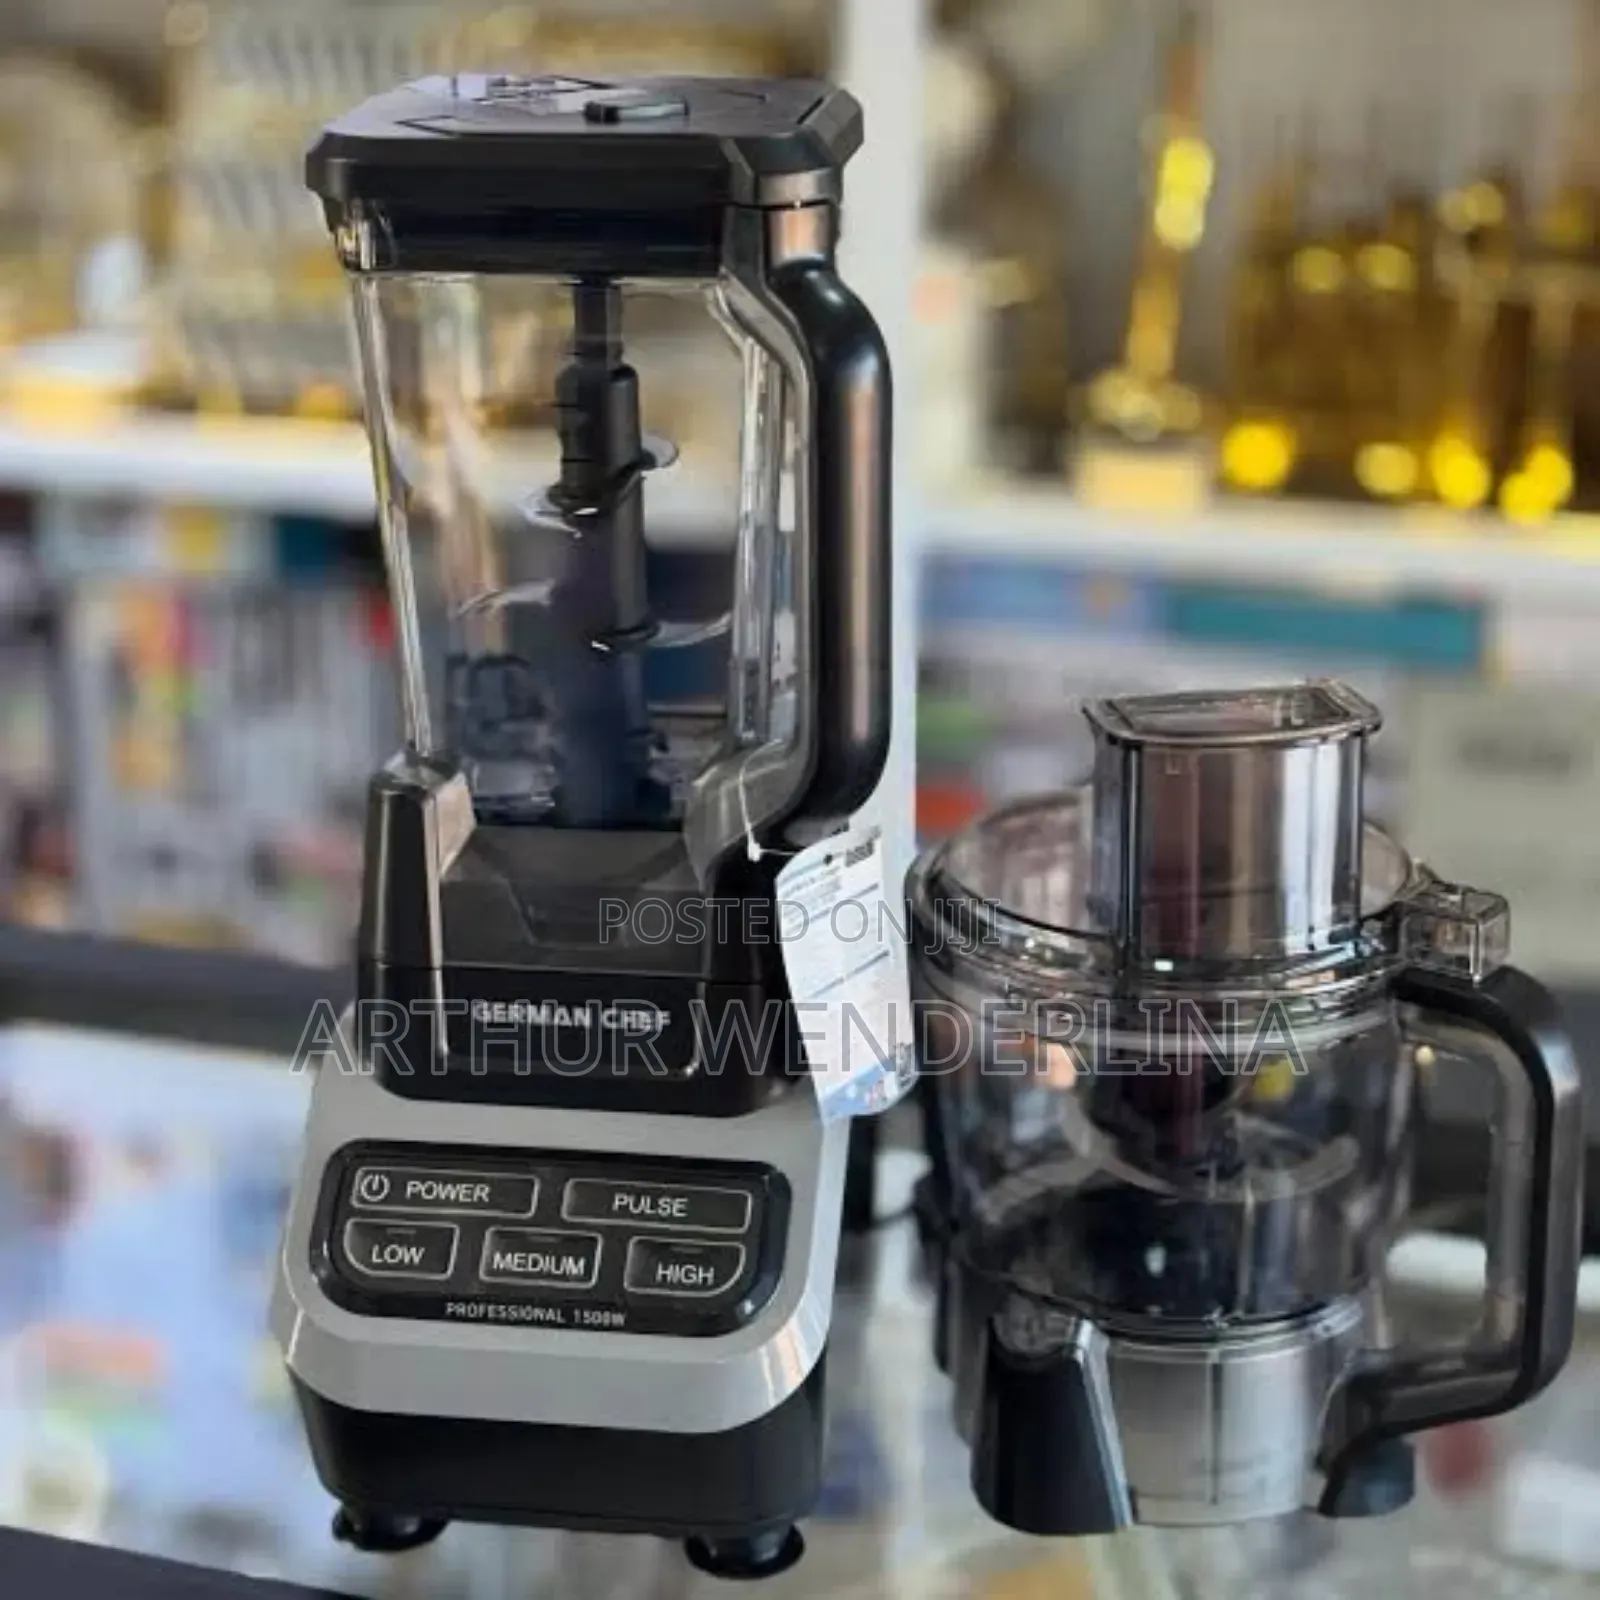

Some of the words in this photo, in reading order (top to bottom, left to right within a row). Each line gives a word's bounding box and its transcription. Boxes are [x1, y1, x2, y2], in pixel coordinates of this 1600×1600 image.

[472, 1001, 592, 1028] GERMAN
[600, 1008, 671, 1032] CHEF
[406, 1179, 491, 1204] POWER
[613, 1193, 689, 1218] PULSE
[371, 1242, 426, 1266] LOW
[492, 1252, 586, 1278] MEDIUM
[656, 1263, 715, 1286] HIGH
[445, 1301, 566, 1324] PROFESSIONAL
